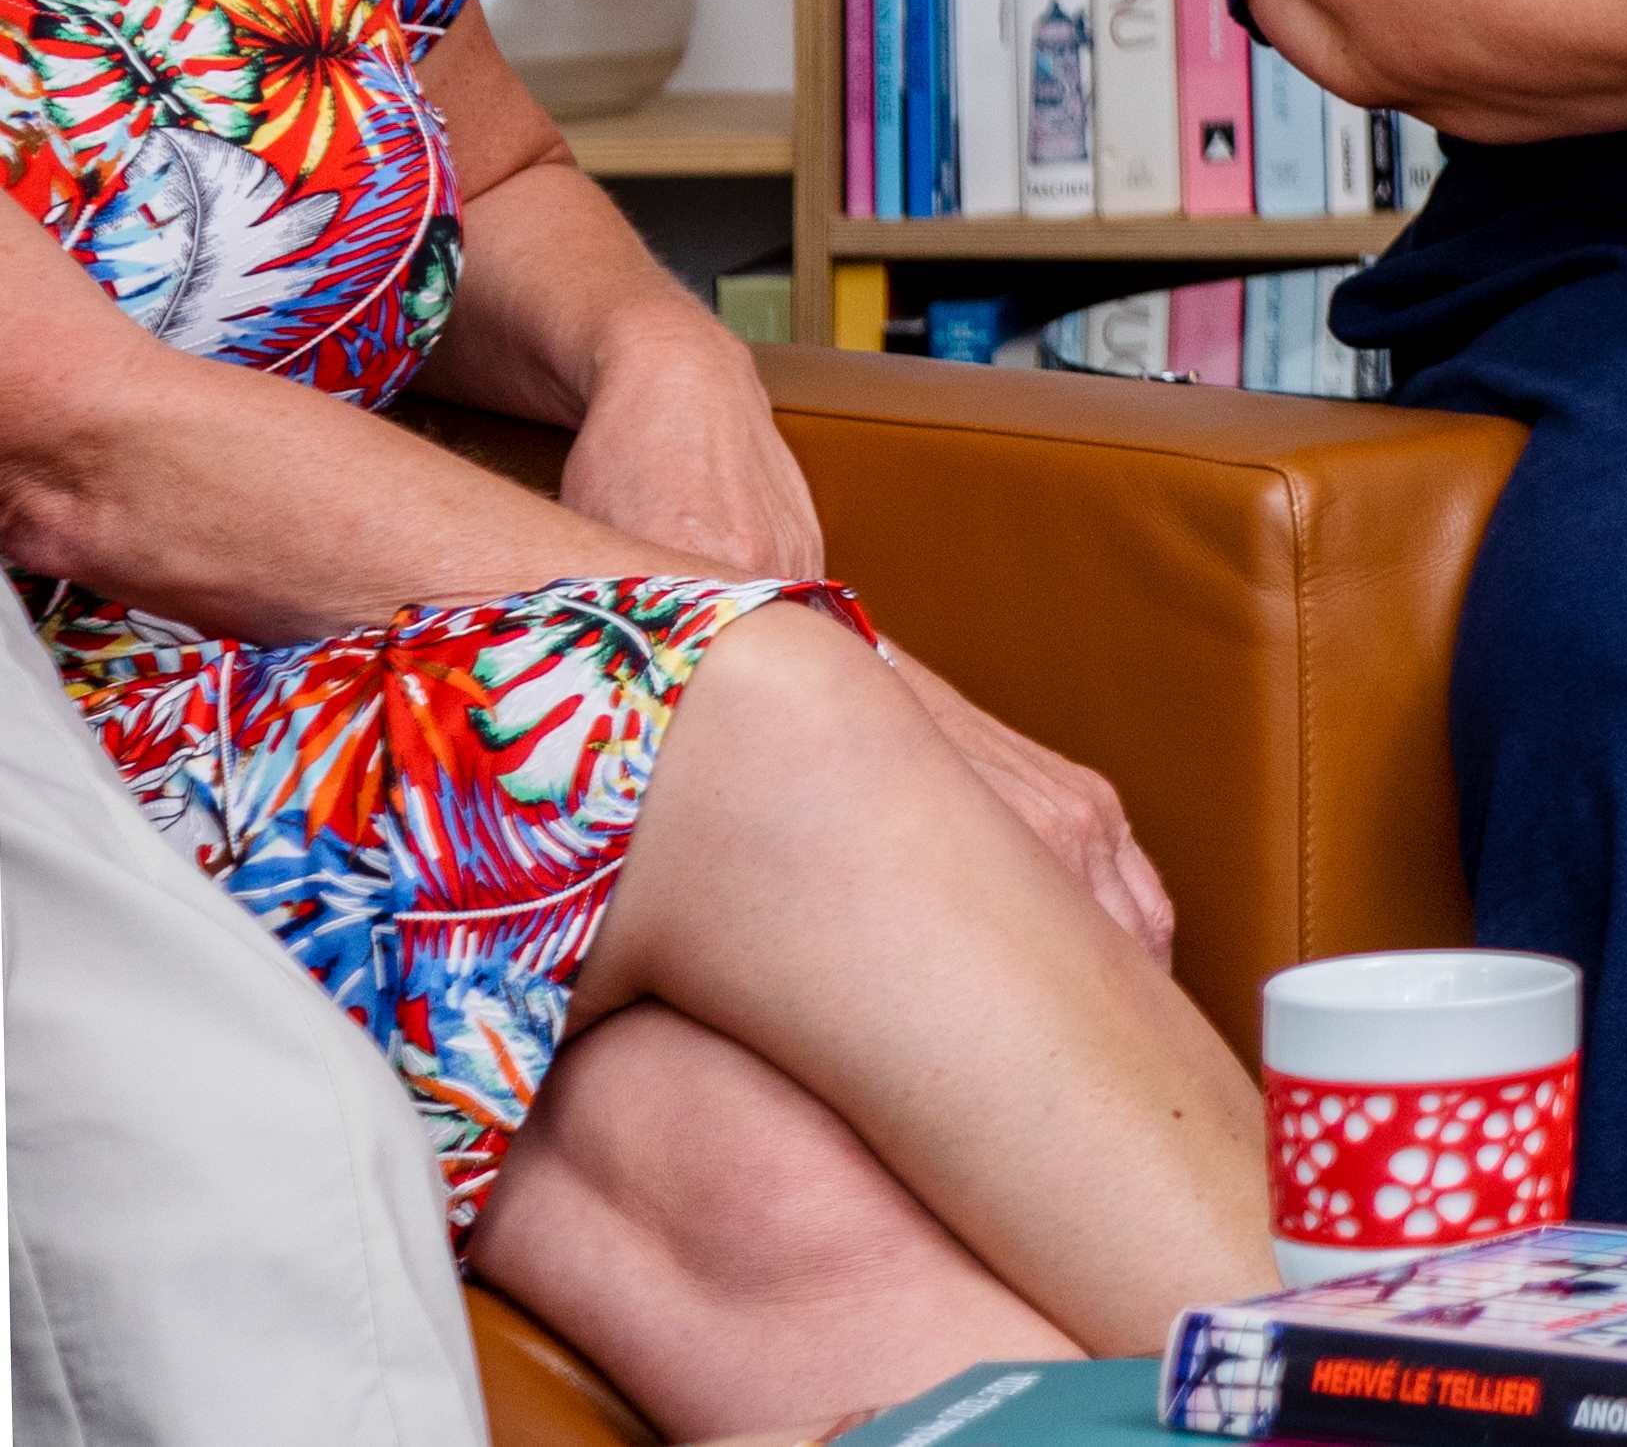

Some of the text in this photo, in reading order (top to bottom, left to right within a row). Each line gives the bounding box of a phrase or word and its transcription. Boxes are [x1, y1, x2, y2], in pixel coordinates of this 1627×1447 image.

[1310, 1358, 1400, 1403] HERVÉ
[1402, 1368, 1436, 1406] LE
[1437, 1370, 1542, 1417] TELLIER
